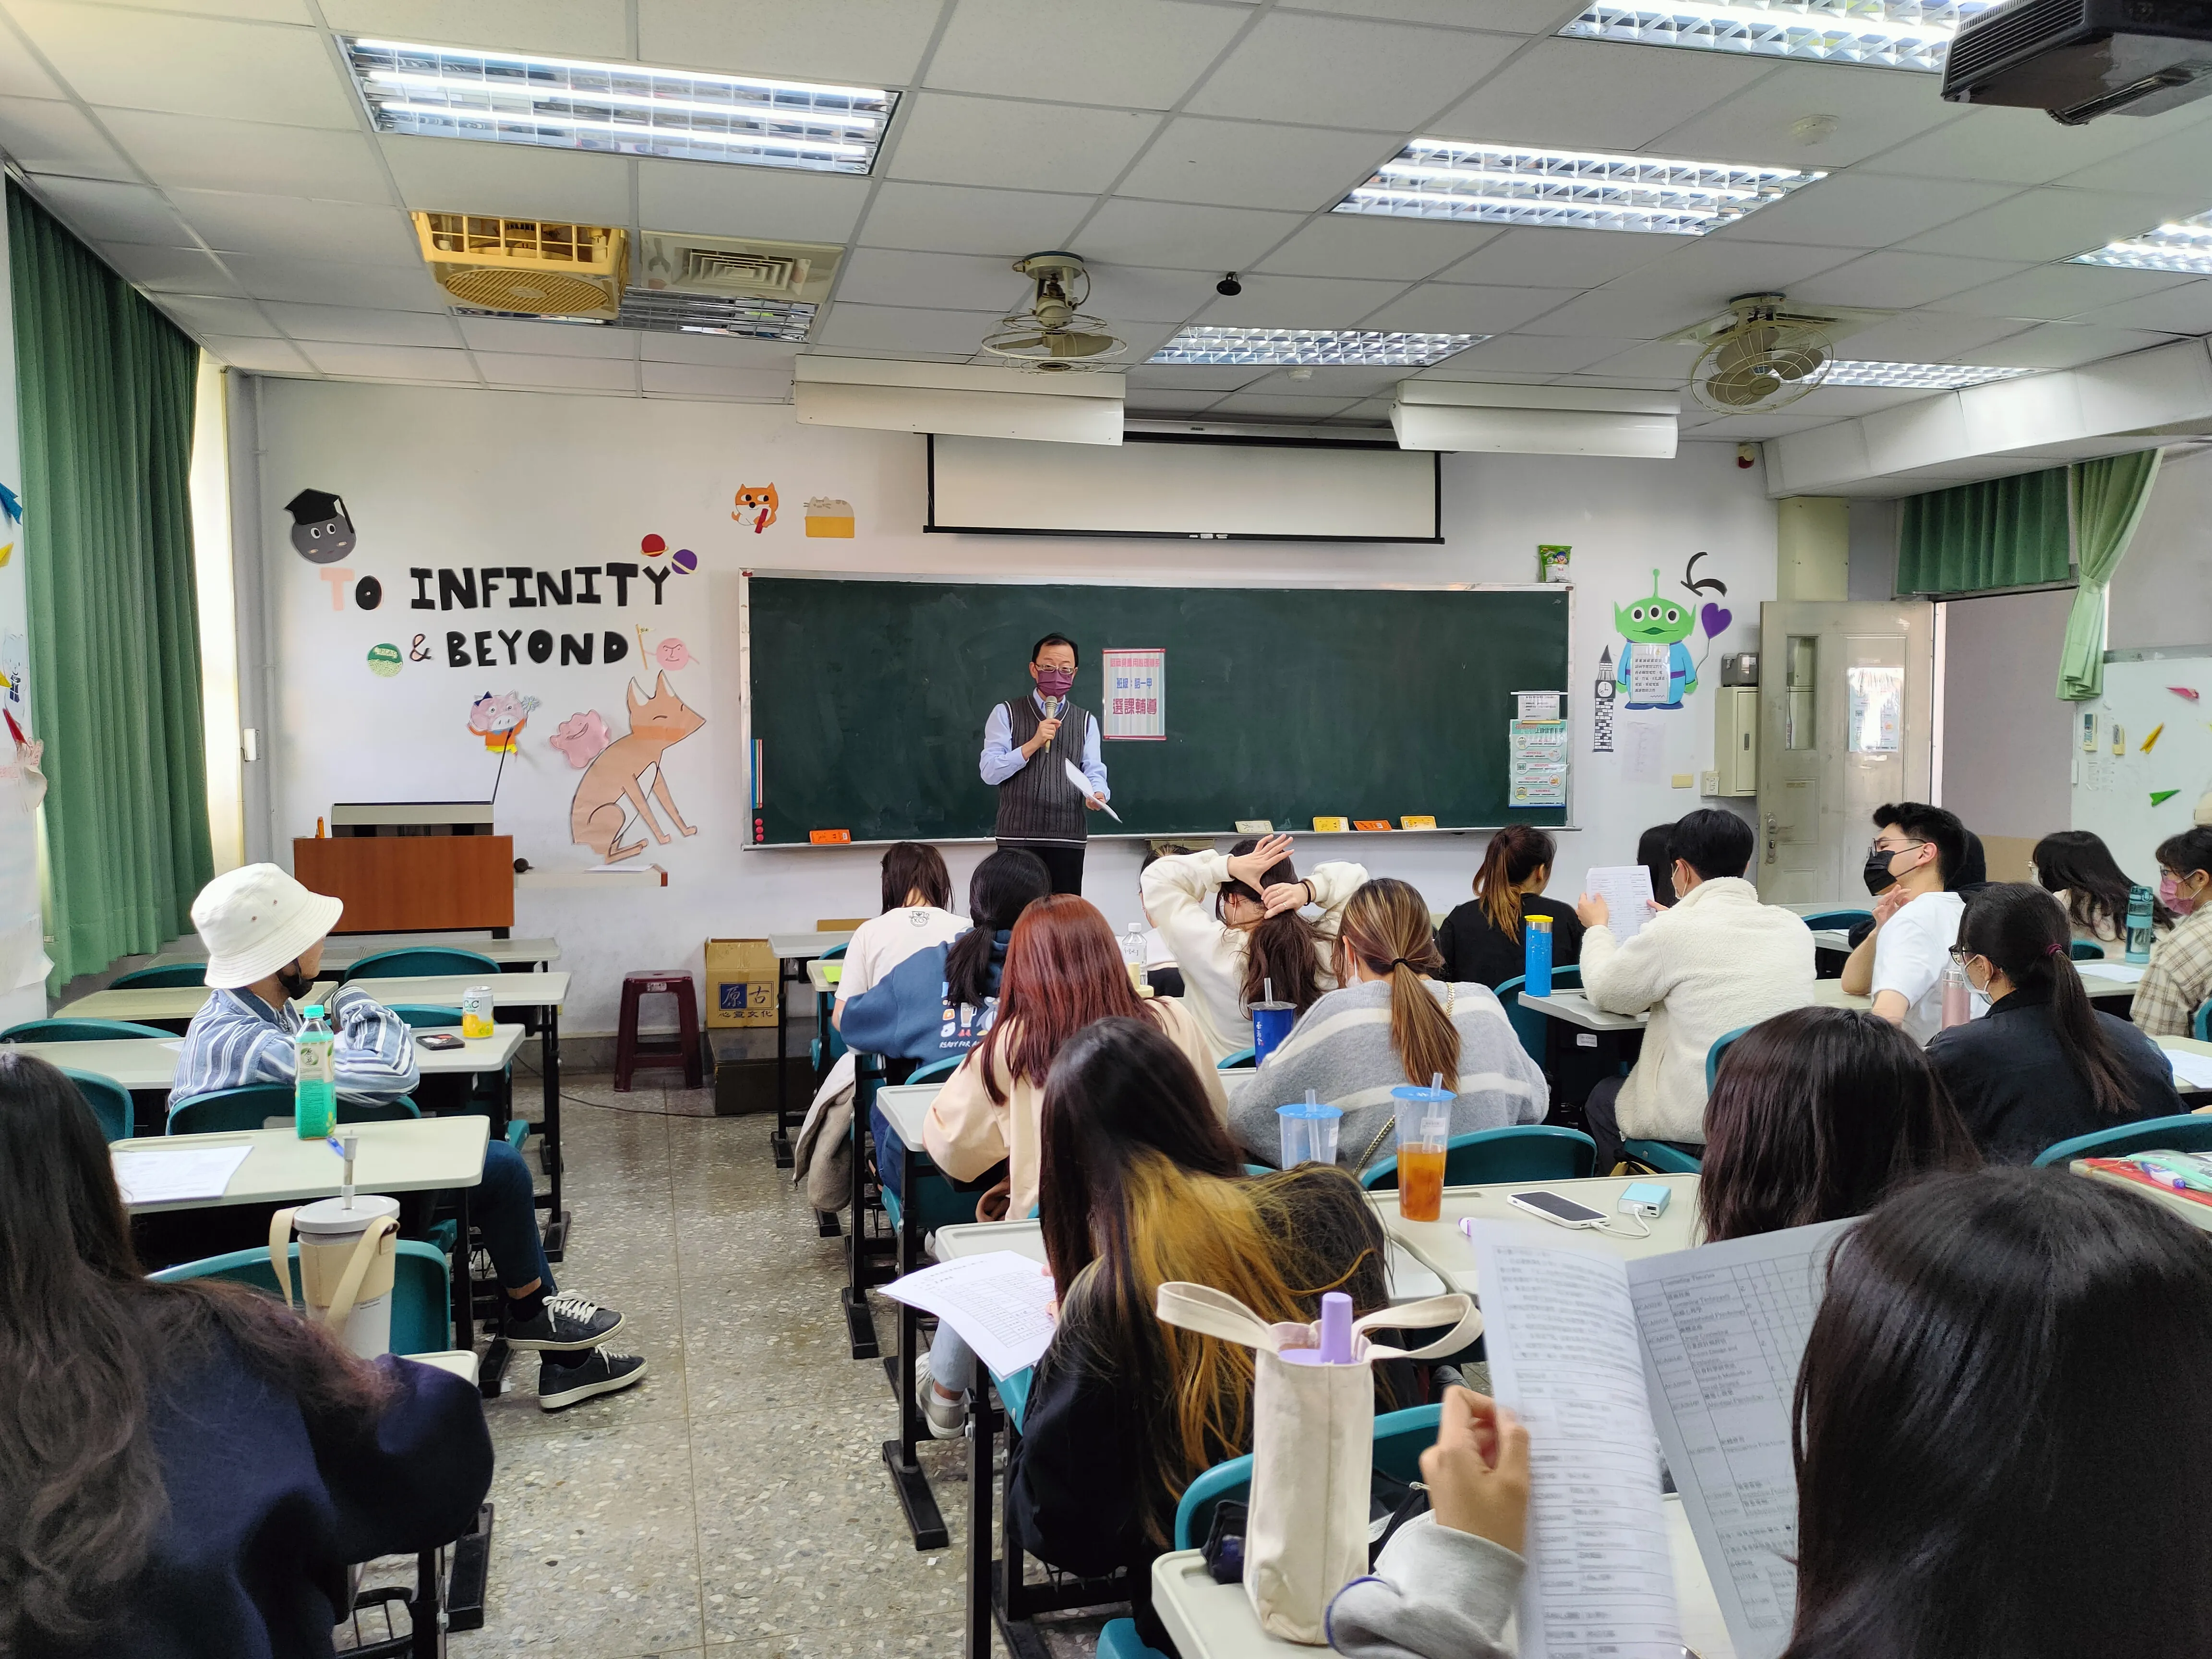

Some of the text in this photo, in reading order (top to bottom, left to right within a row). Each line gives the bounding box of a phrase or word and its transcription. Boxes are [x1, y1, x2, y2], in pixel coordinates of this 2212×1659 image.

[320, 562, 671, 611] TO INFINITY
[409, 629, 629, 667] & BEYOND
[1113, 698, 1157, 715] 選課輔導
